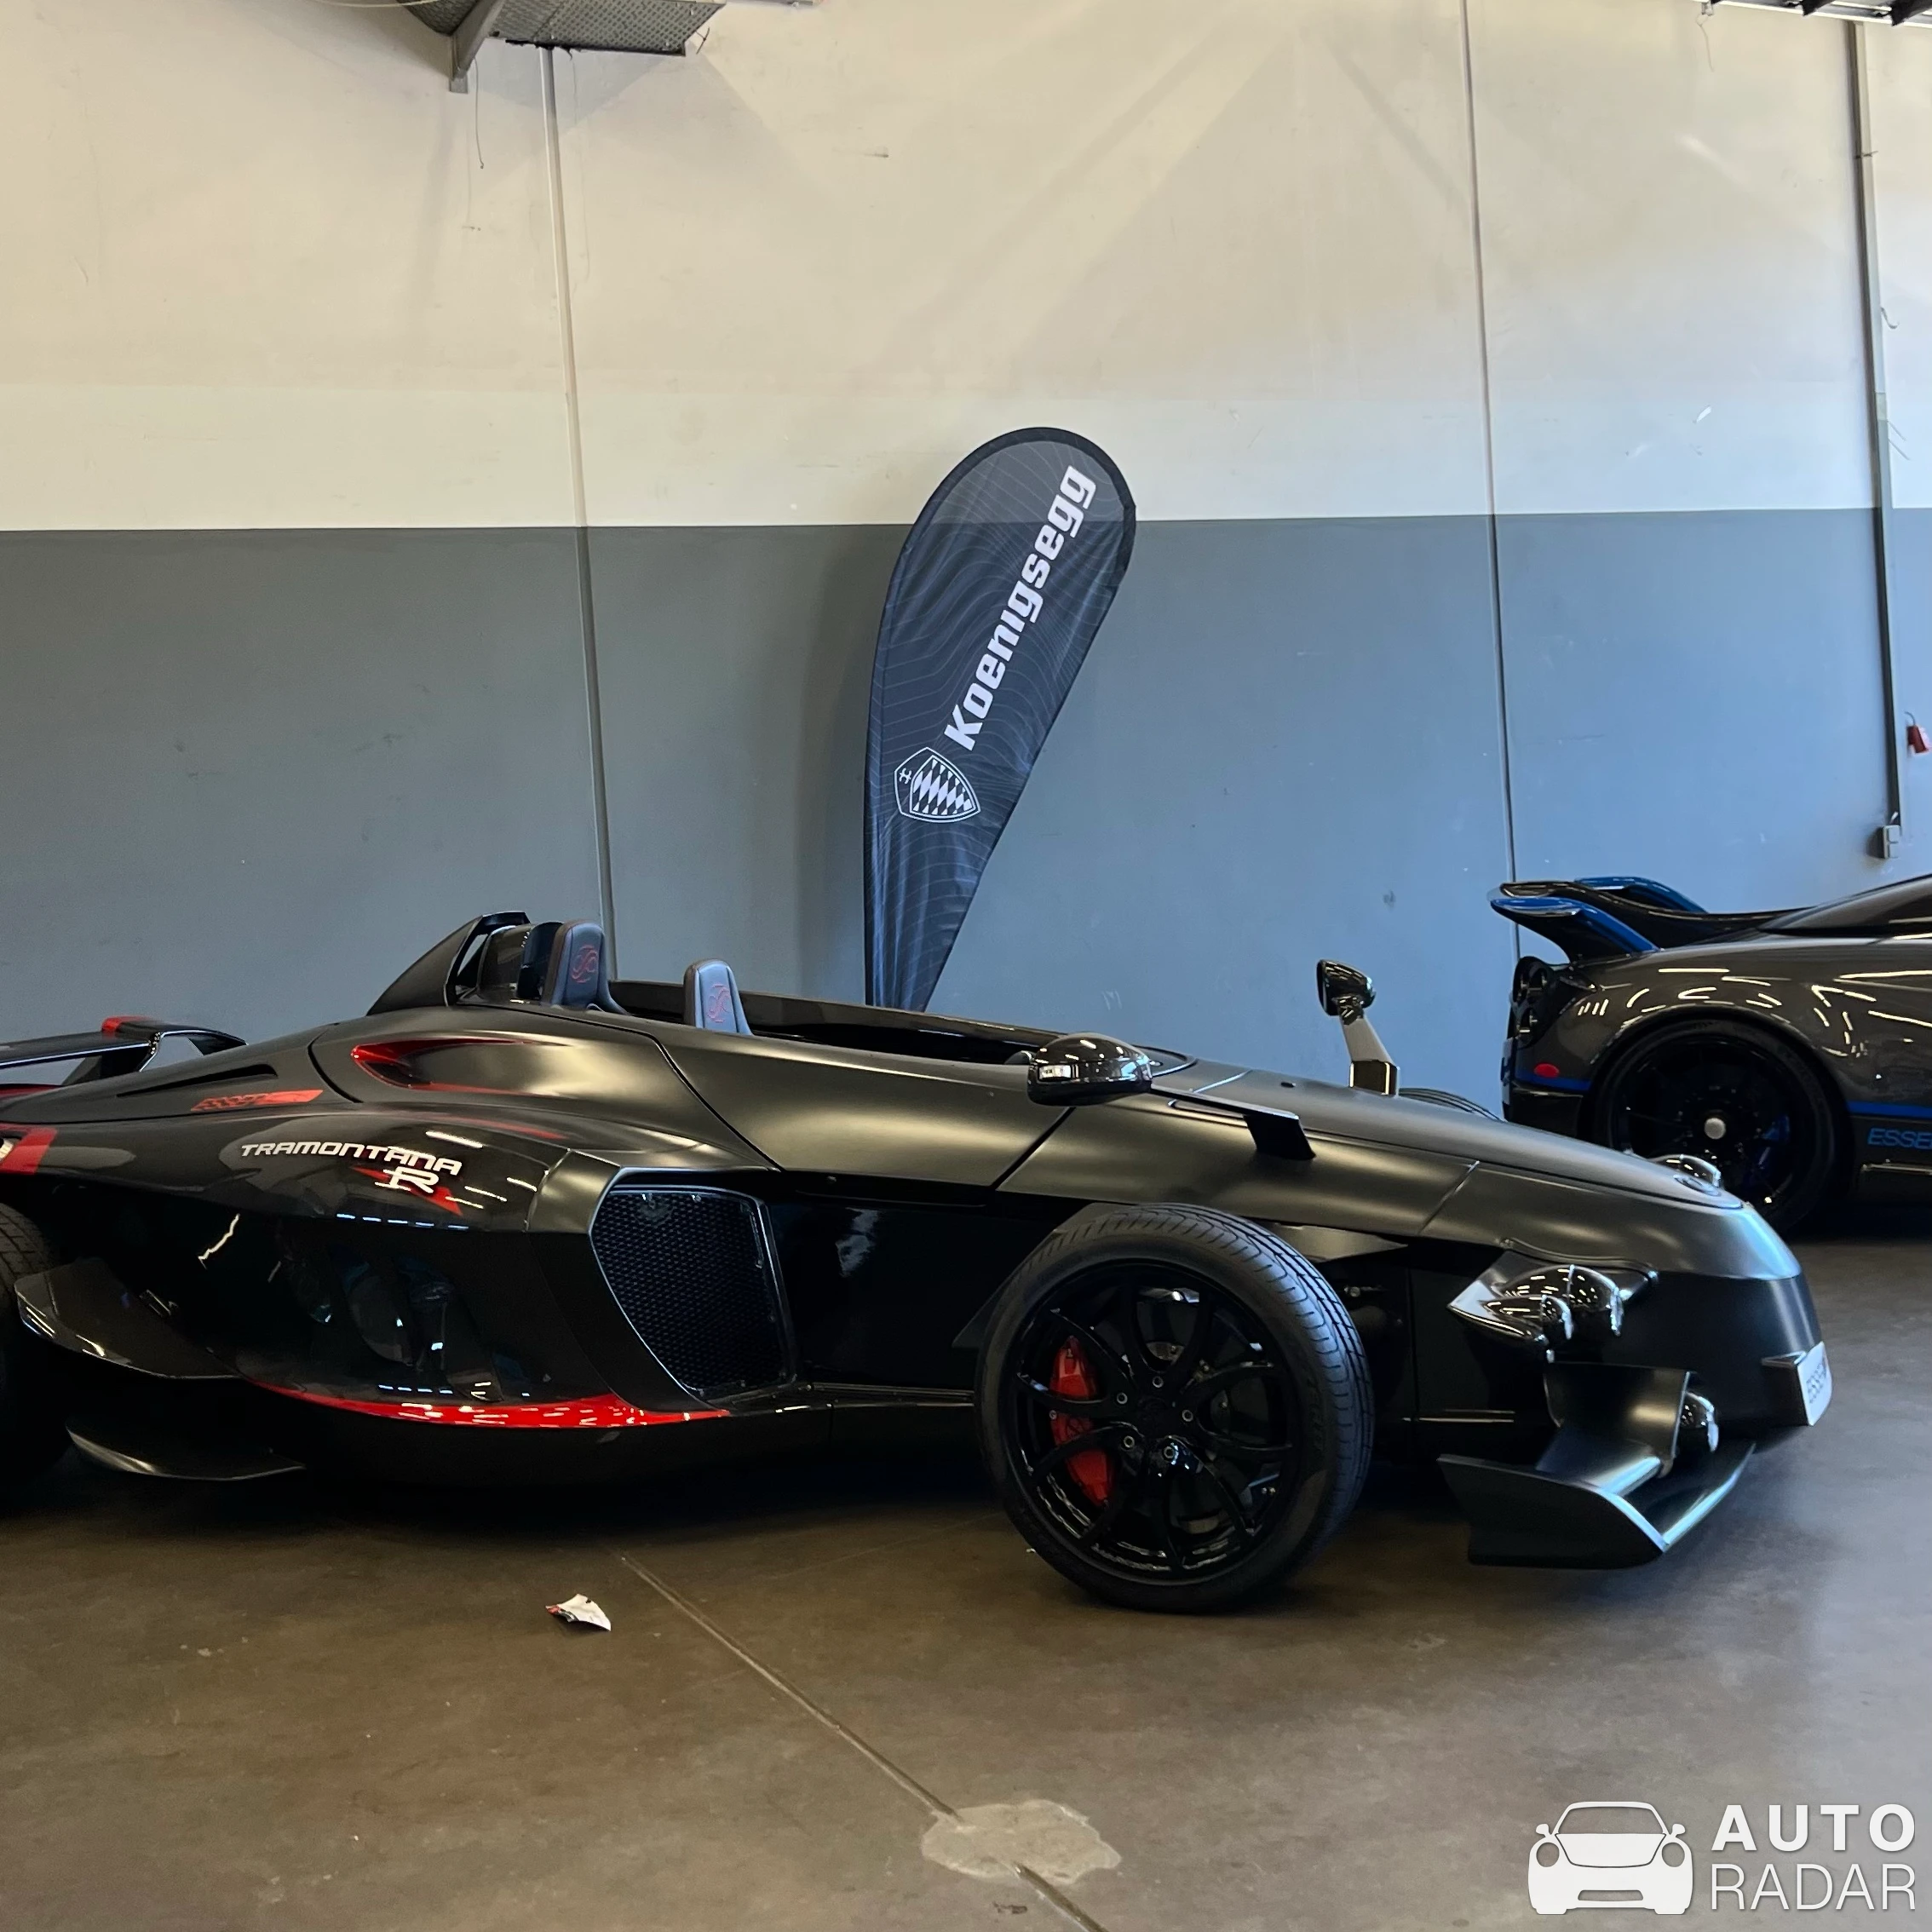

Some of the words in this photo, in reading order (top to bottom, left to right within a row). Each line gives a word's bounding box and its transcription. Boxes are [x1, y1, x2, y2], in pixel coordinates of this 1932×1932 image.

[944, 464, 1097, 751] Koenigsegg
[1867, 1127, 1932, 1150] ESSE
[241, 1141, 462, 1176] TRAMONTANA
